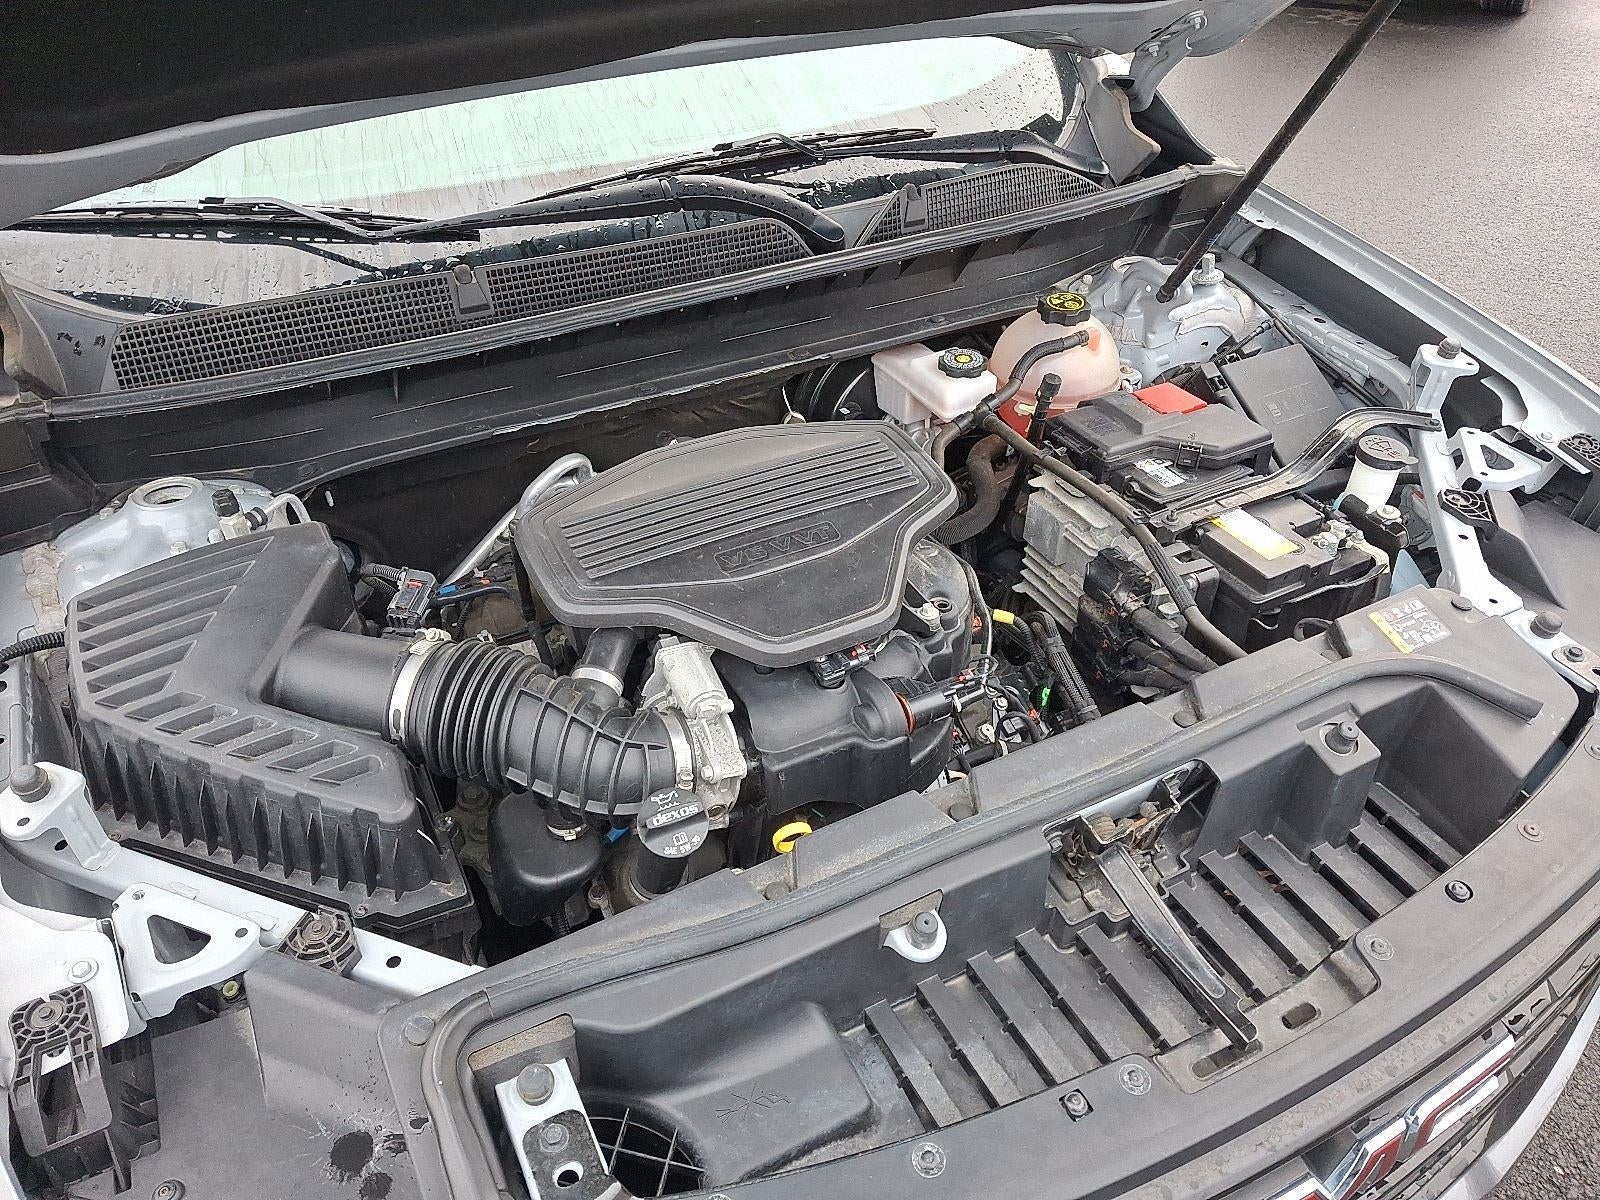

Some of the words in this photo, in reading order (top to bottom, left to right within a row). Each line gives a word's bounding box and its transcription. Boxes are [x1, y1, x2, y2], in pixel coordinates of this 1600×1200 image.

[720, 545, 768, 567] V6
[769, 525, 830, 552] VVT
[653, 804, 699, 827] dexos
[663, 846, 678, 855] SAE
